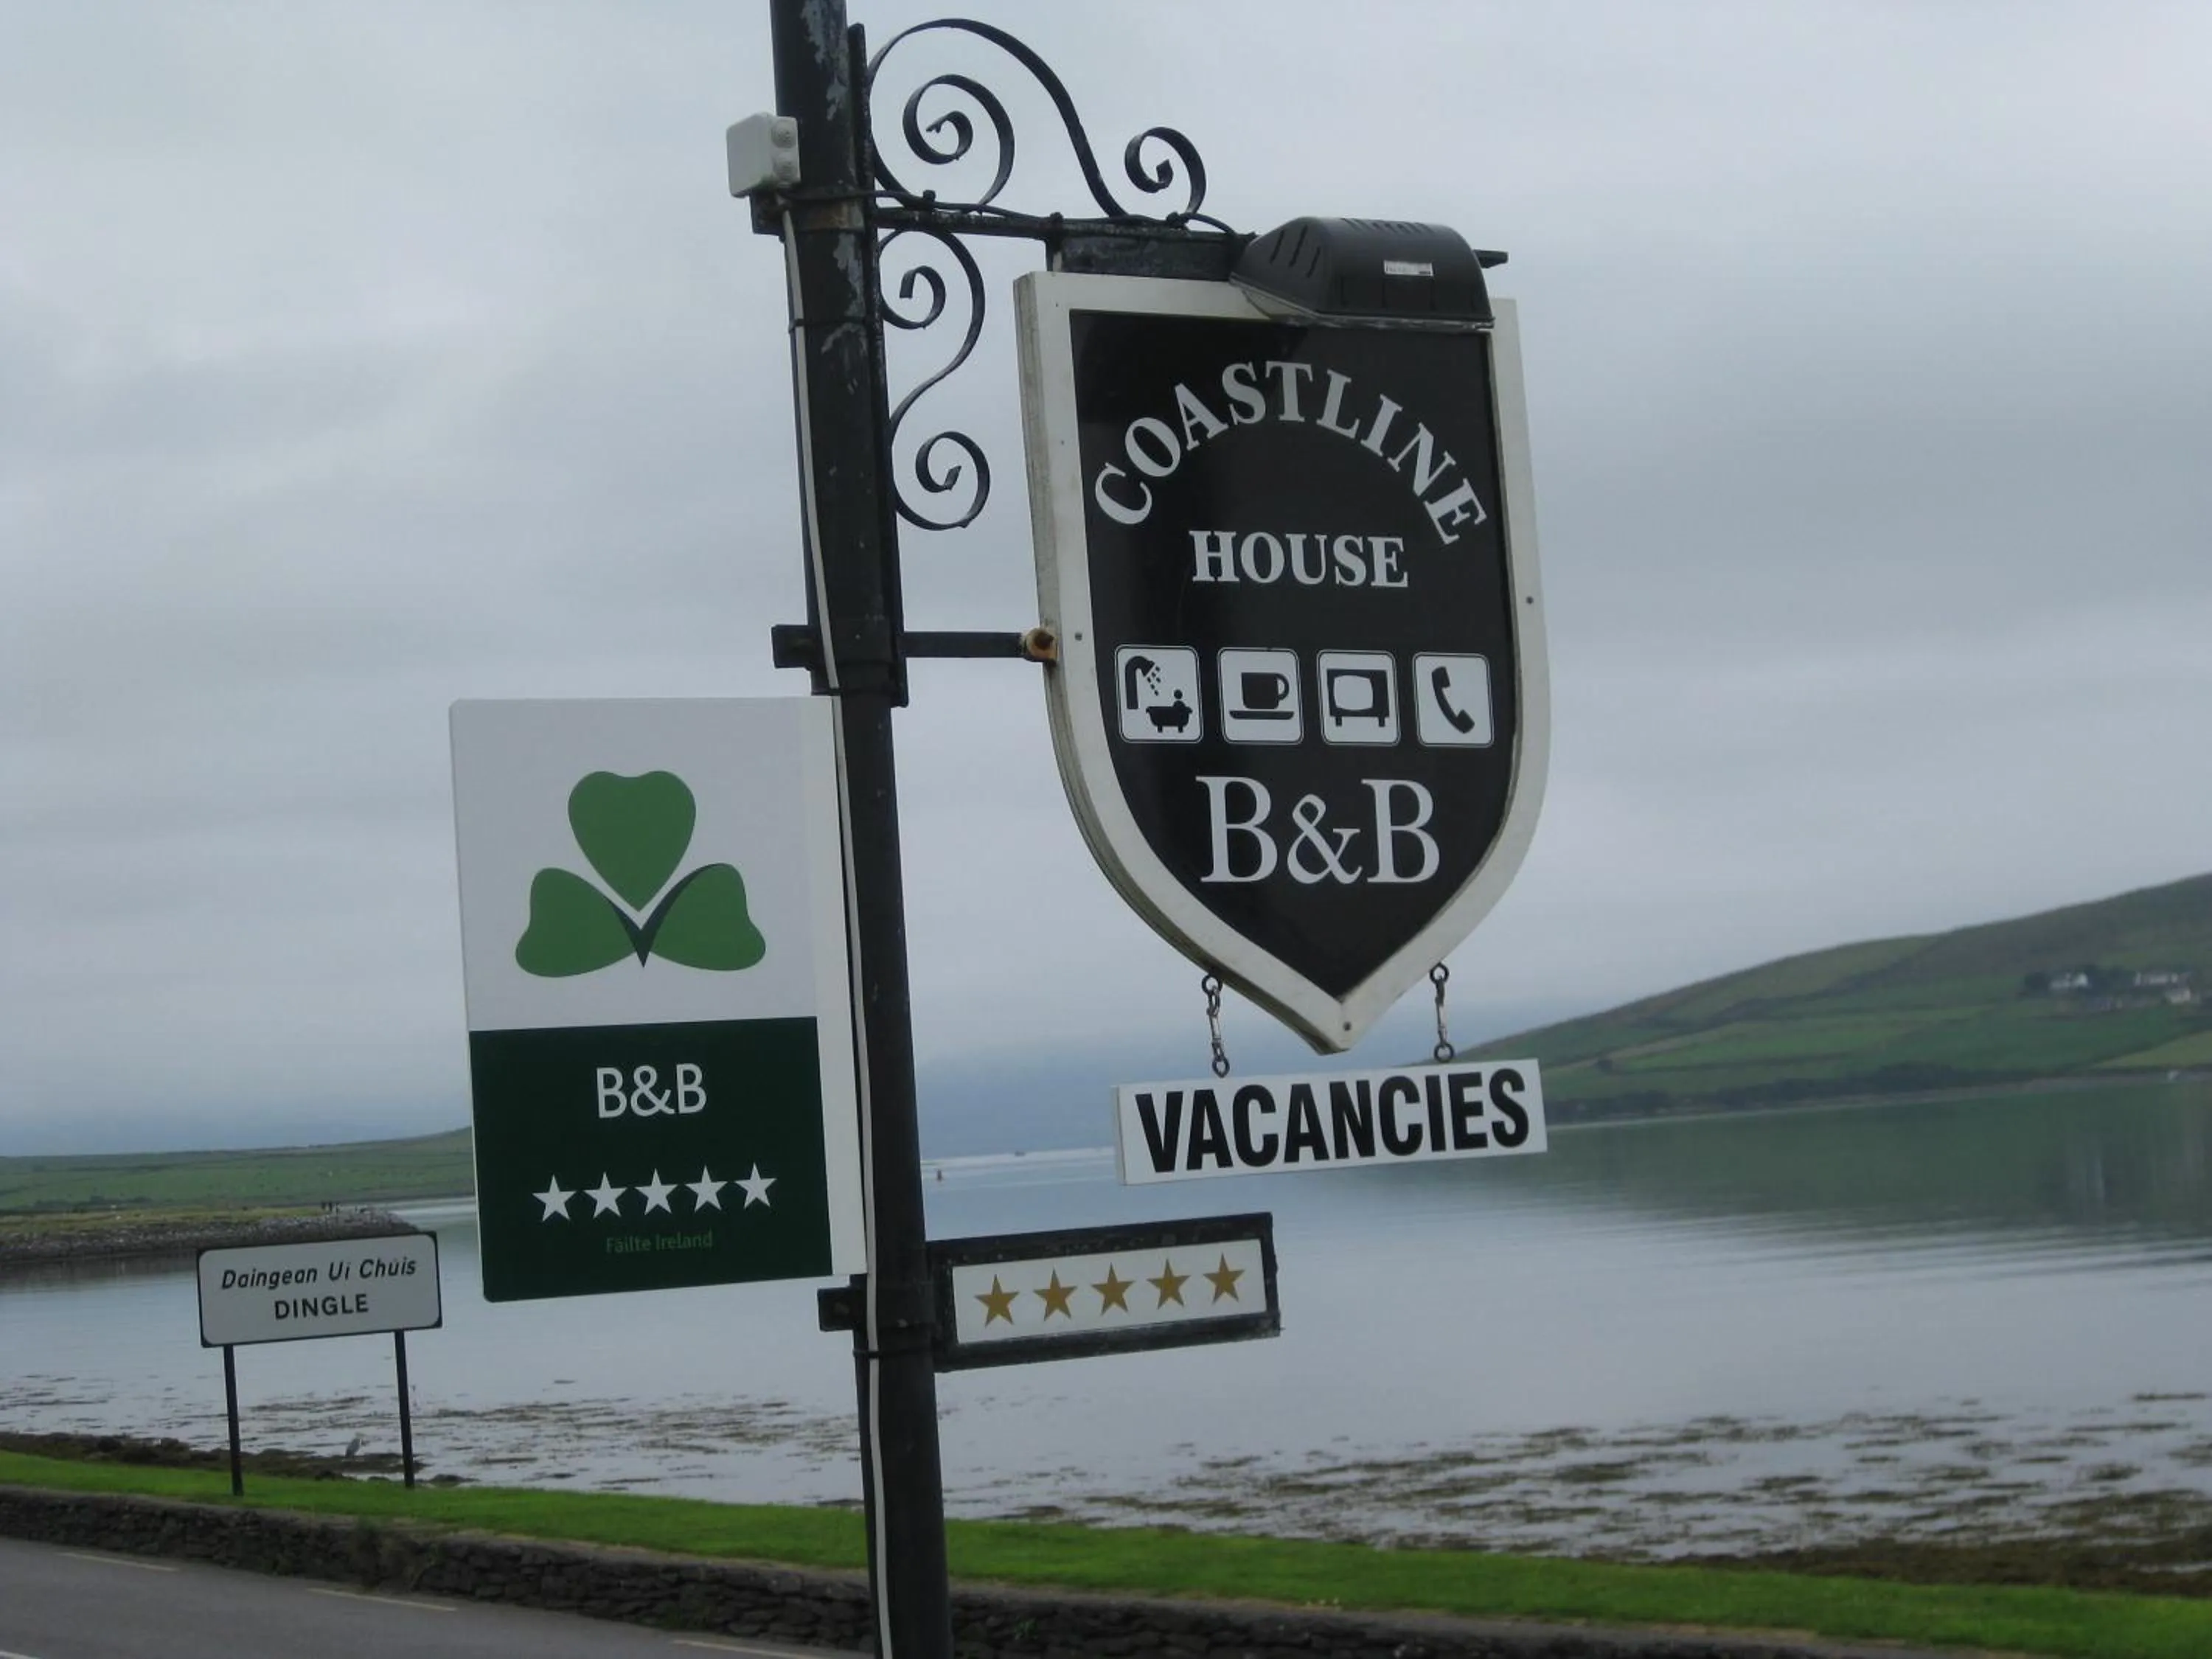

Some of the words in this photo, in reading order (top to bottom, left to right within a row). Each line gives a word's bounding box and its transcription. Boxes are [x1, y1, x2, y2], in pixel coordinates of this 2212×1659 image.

[1095, 361, 1487, 545] COASTLINE
[1189, 530, 1409, 588] HOUSE
[1195, 776, 1440, 884] B&B
[597, 1063, 708, 1119] B&B
[1135, 1068, 1529, 1173] VACANCIES
[655, 1228, 713, 1251] Ireland
[222, 1267, 318, 1290] Daingean
[275, 1294, 369, 1320] DINGLE
